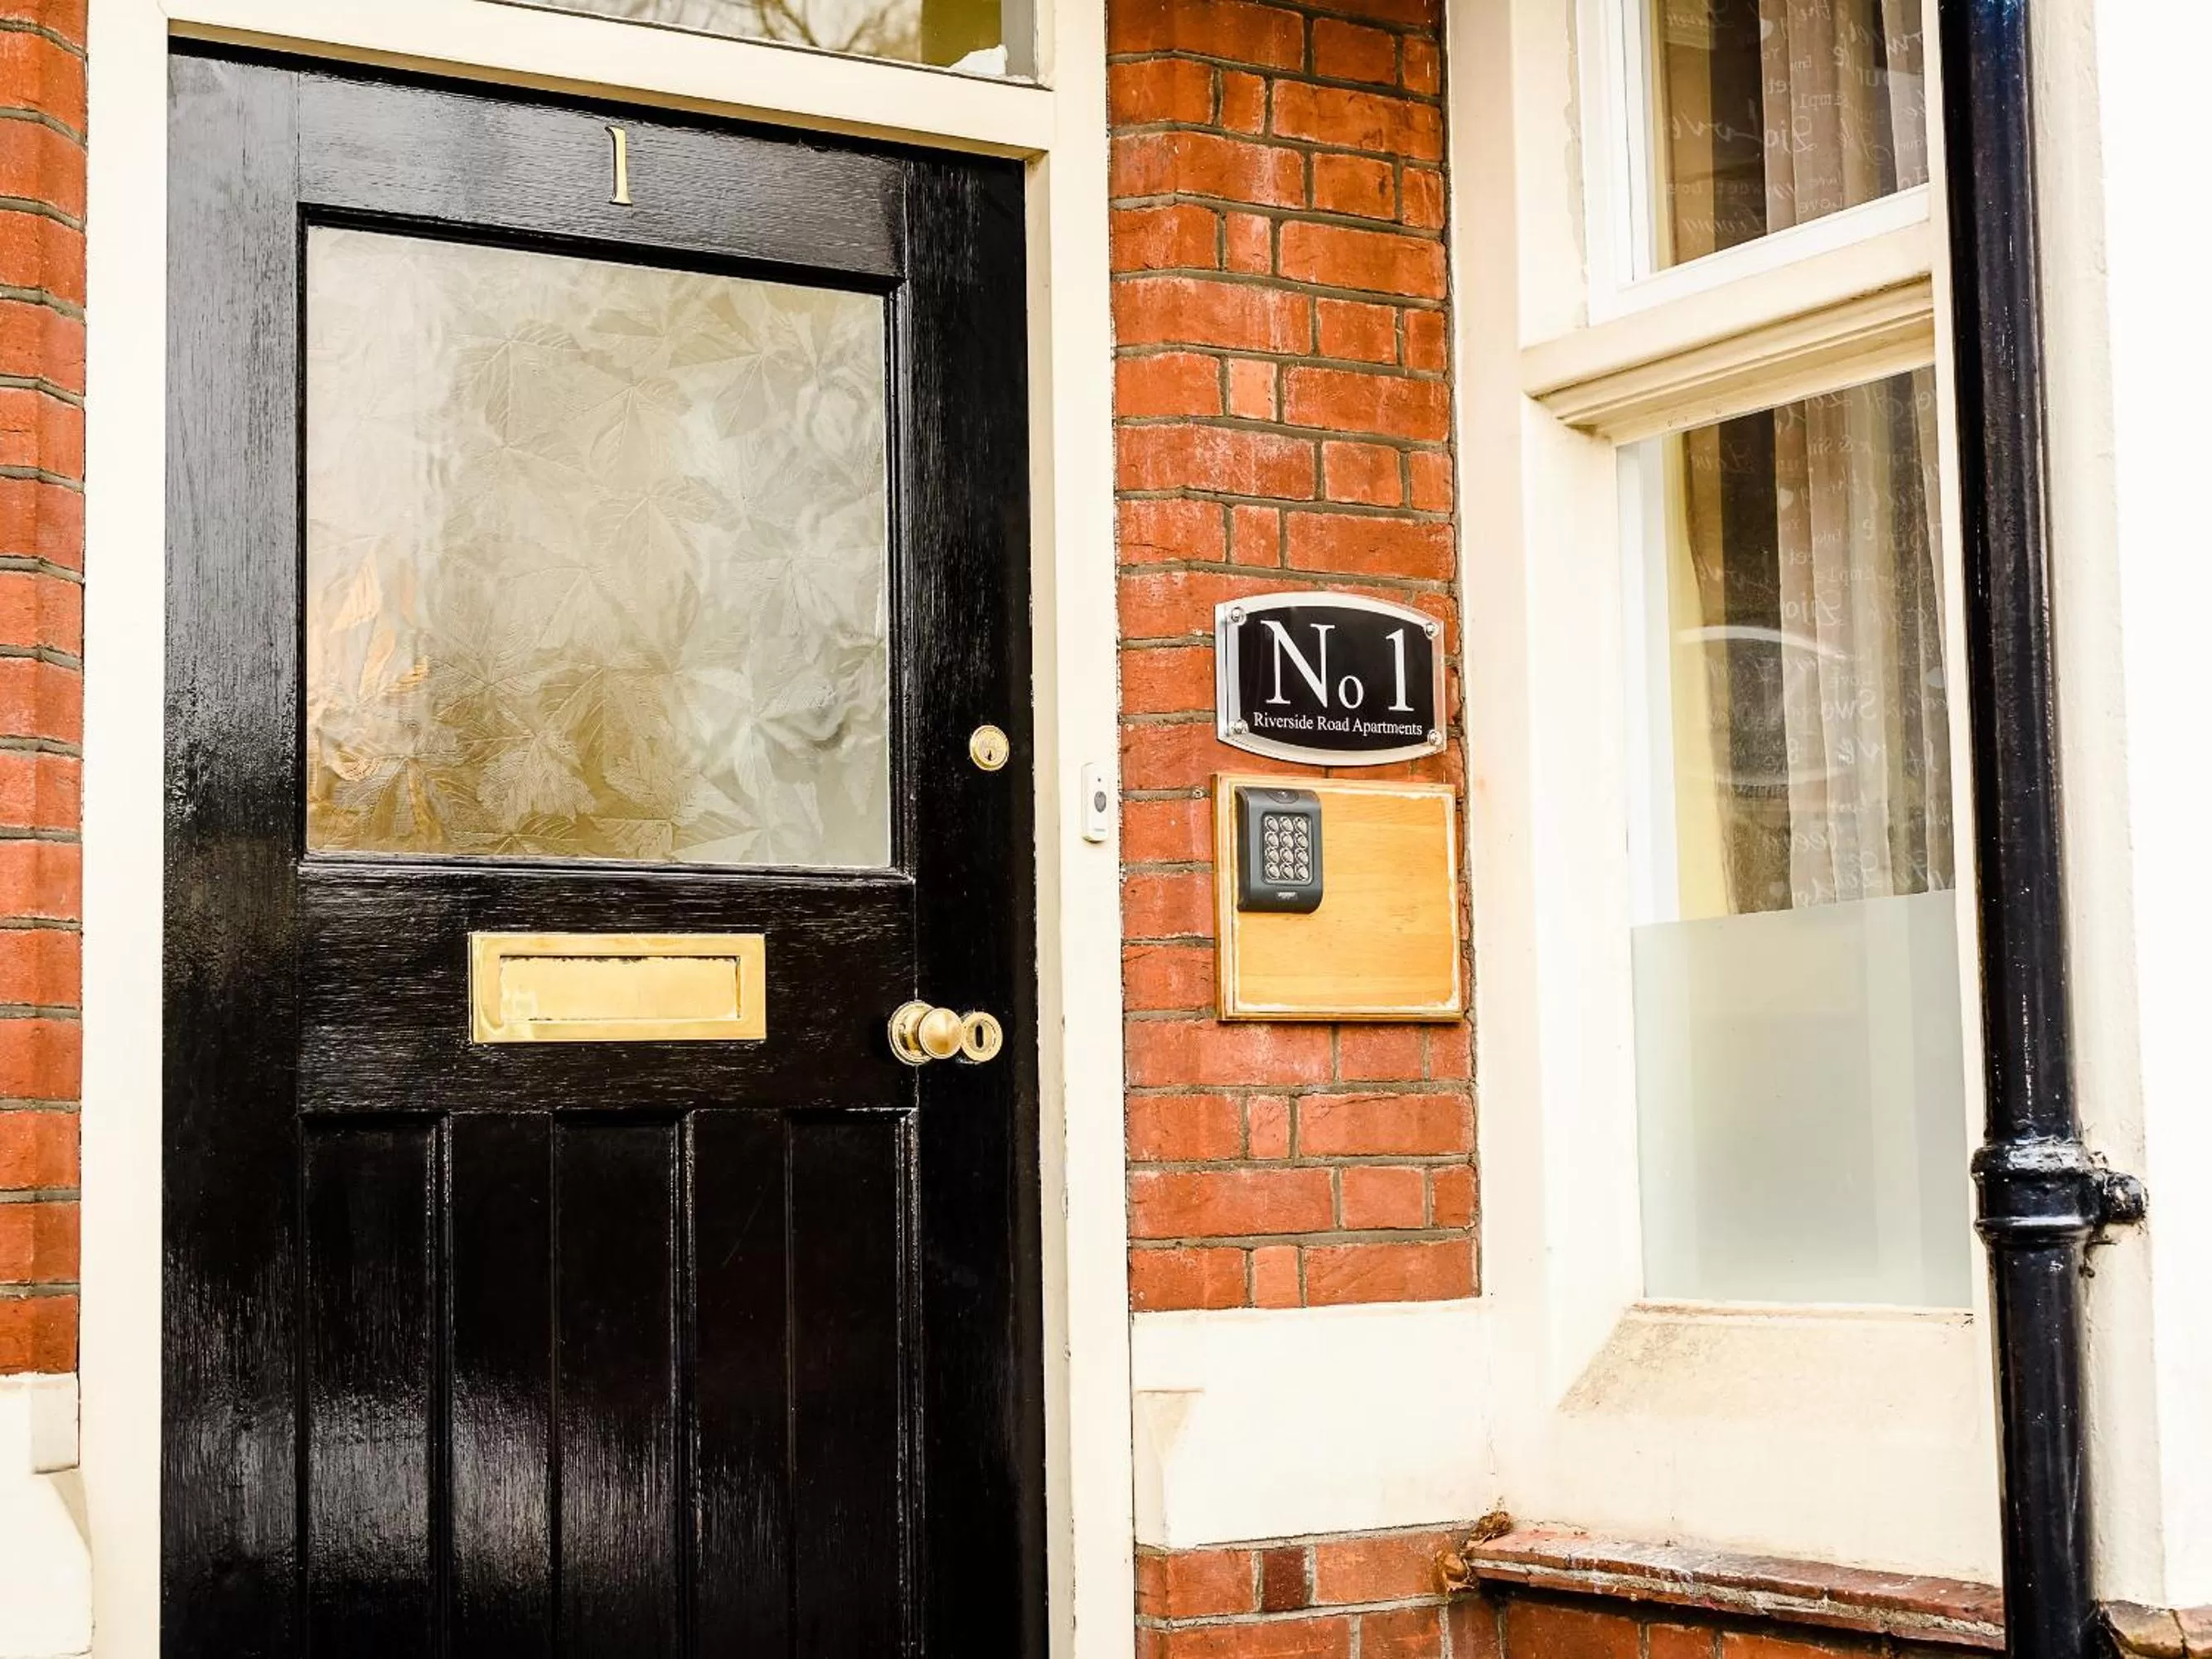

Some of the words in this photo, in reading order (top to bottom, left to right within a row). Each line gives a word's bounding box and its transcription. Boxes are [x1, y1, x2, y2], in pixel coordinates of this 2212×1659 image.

[603, 125, 632, 206] 1
[1260, 620, 1365, 709] No
[1386, 628, 1415, 712] 1
[1253, 711, 1314, 729] Riverside
[1317, 715, 1349, 732] Road
[1352, 718, 1422, 736] Apartments
